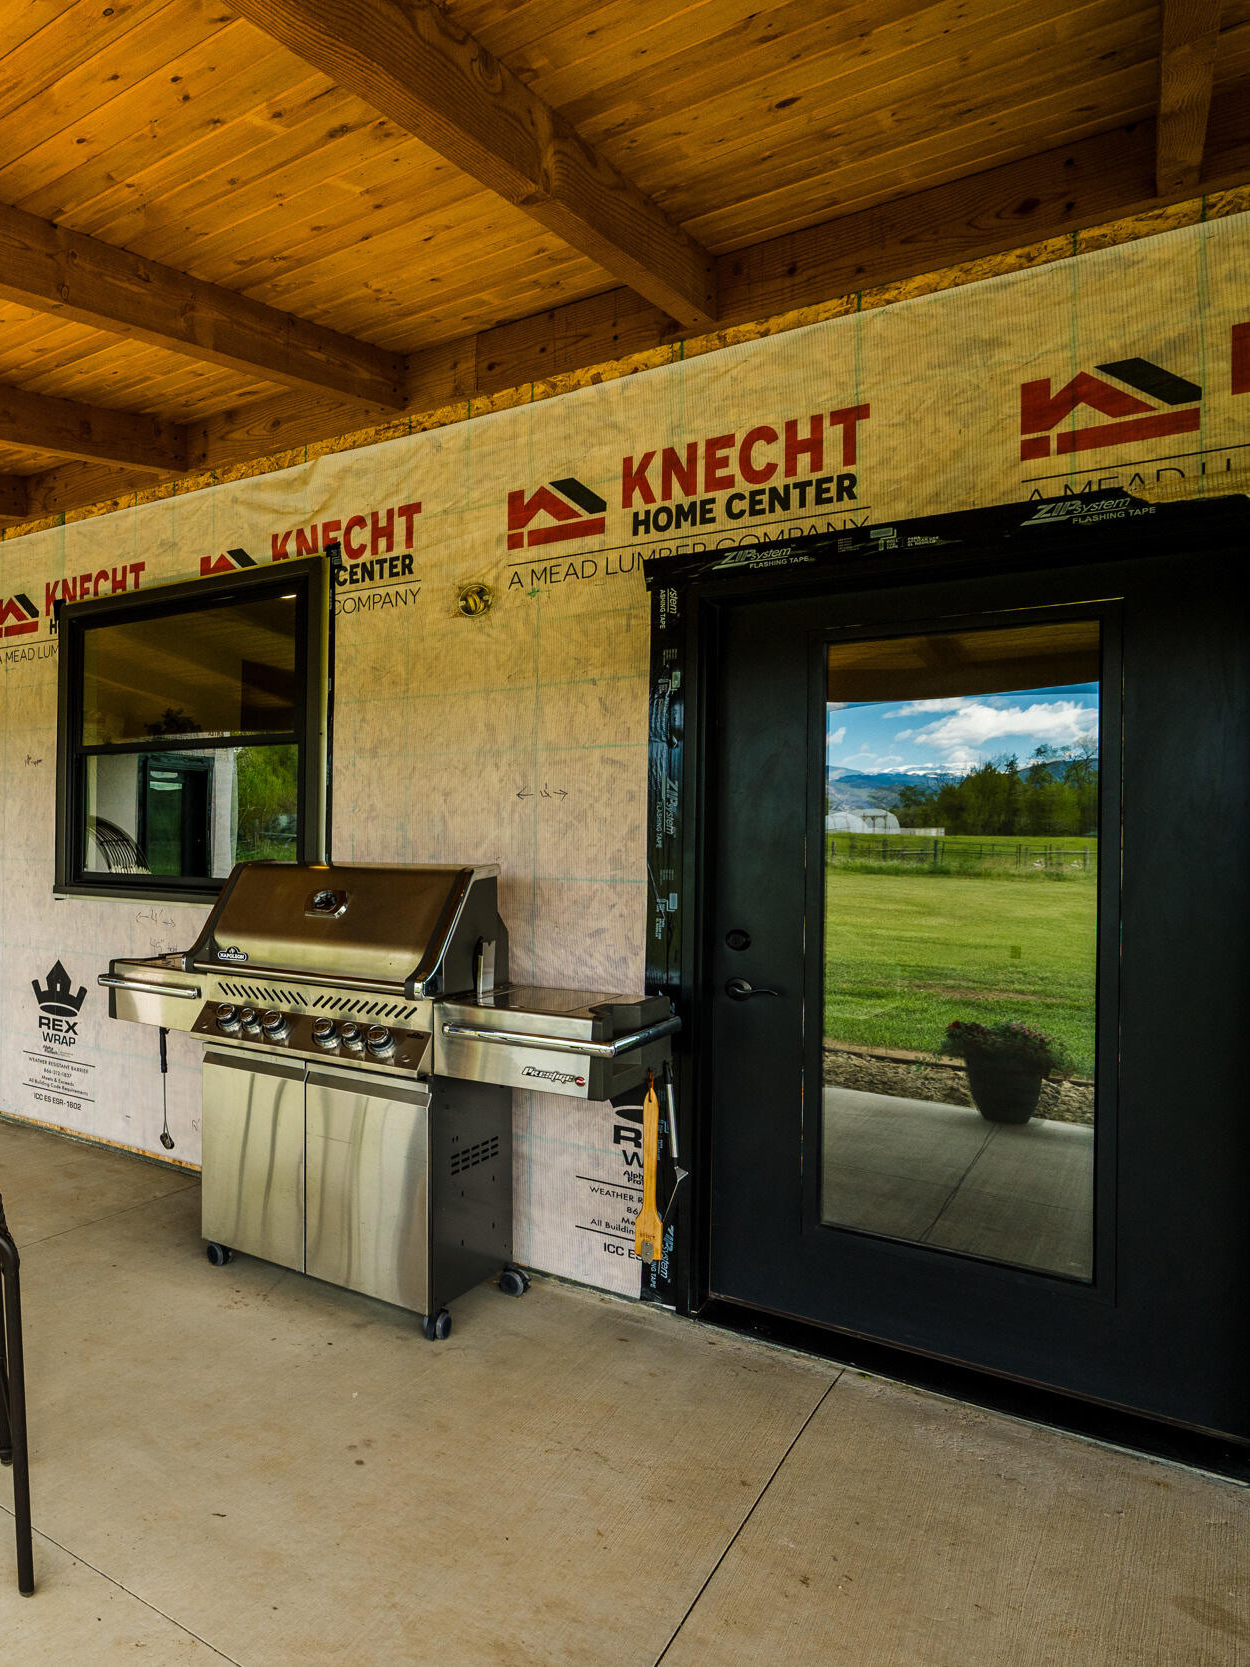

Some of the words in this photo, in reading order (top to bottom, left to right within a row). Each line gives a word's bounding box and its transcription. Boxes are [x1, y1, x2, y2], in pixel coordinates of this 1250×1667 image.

[622, 403, 870, 509] KNECHT
[632, 497, 716, 536] HOME
[725, 473, 857, 517] CENTER
[1072, 511, 1126, 525] FLASHING
[1128, 506, 1156, 517] TAPE
[271, 502, 422, 563] KNECHT
[335, 554, 414, 587] CENTER
[749, 558, 787, 569] FLASHING
[788, 555, 810, 565] TAPE
[508, 573, 524, 590] A
[531, 559, 598, 587] MEAD
[335, 588, 421, 616] COMPANY
[6, 647, 35, 663] MEAD
[38, 645, 59, 659] LUM
[655, 832, 663, 848] TAPE
[38, 1015, 78, 1035] REX
[42, 1031, 76, 1047] WRAP
[34, 1092, 44, 1101] ICC
[44, 1095, 52, 1103] ES
[623, 1171, 644, 1181] Alph
[589, 1186, 634, 1203] WEATHER
[590, 1219, 602, 1228] All
[605, 1221, 635, 1235] Buildin
[604, 1243, 625, 1257] ICC
